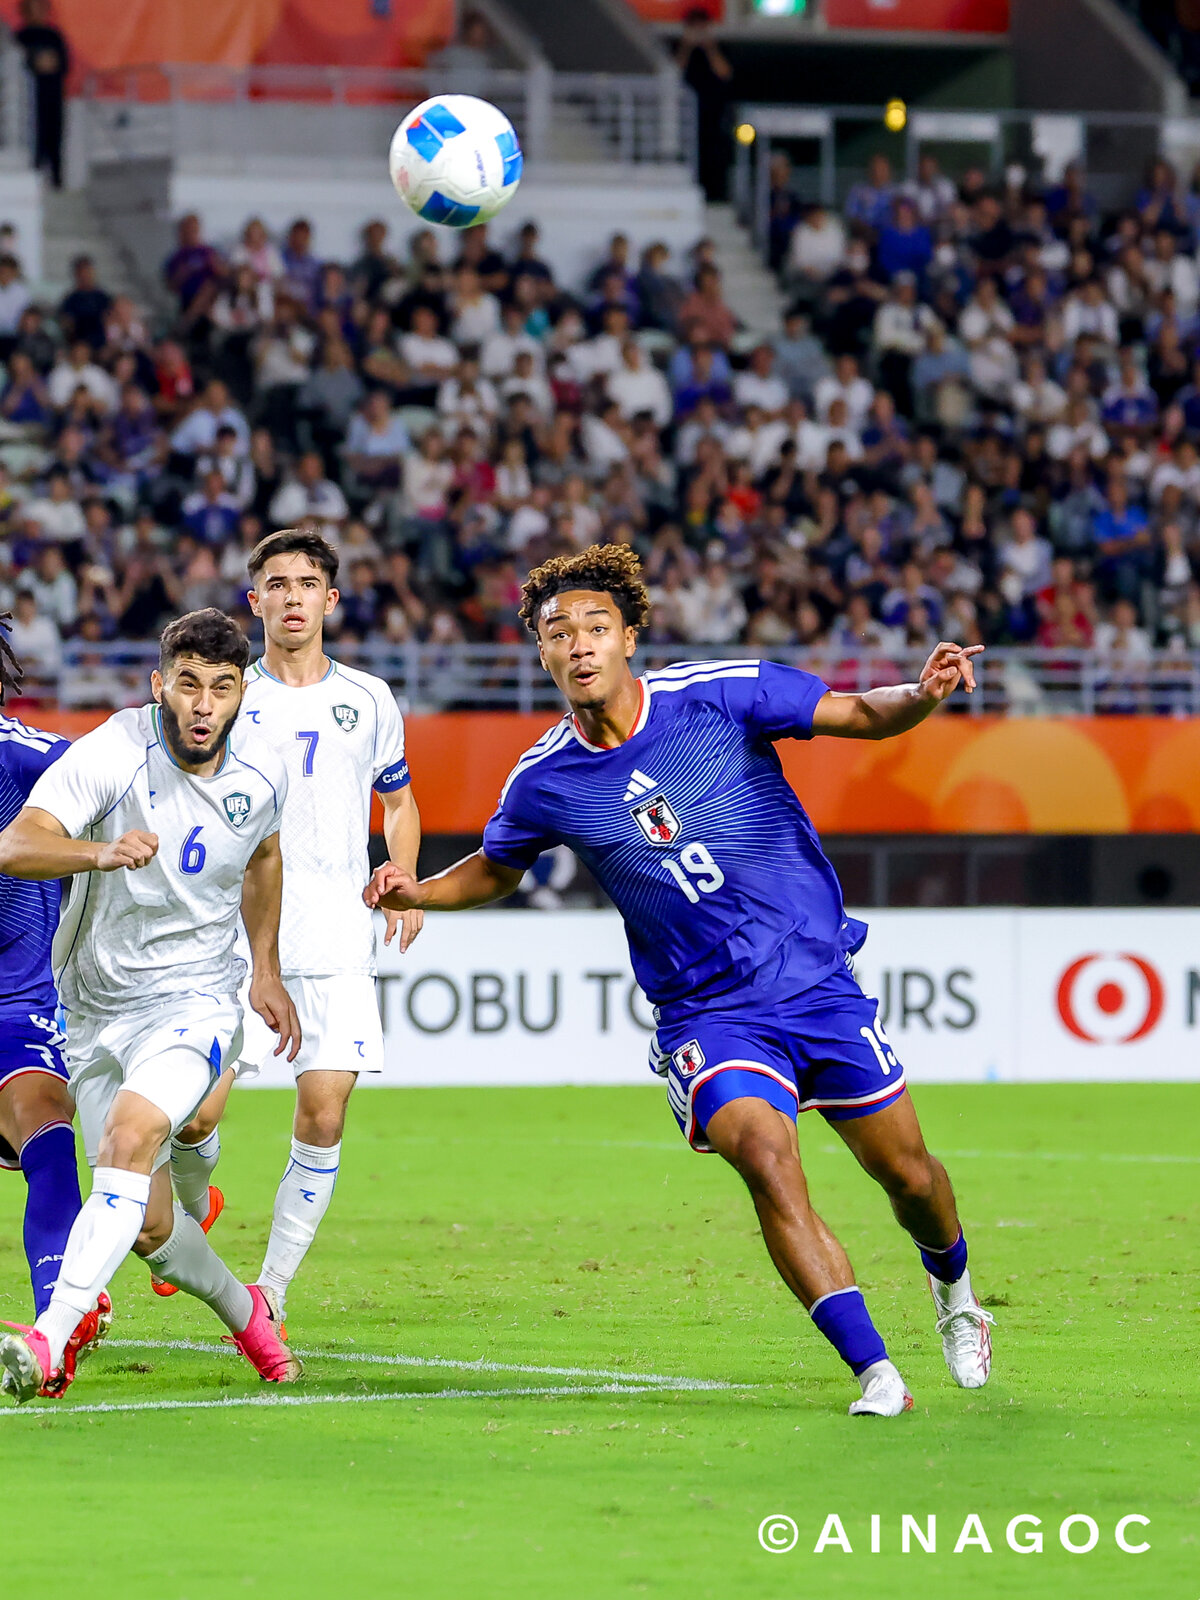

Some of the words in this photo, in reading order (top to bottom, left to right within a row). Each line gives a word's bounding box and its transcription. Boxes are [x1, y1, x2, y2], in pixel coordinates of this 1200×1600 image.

[334, 706, 357, 722] UFA
[296, 731, 319, 777] 7
[226, 797, 249, 813] UFA
[639, 799, 658, 813] JAPAN
[179, 825, 207, 876] 6
[660, 842, 725, 904] 19
[377, 972, 559, 1034] TOBU
[35, 1254, 64, 1268] JAP
